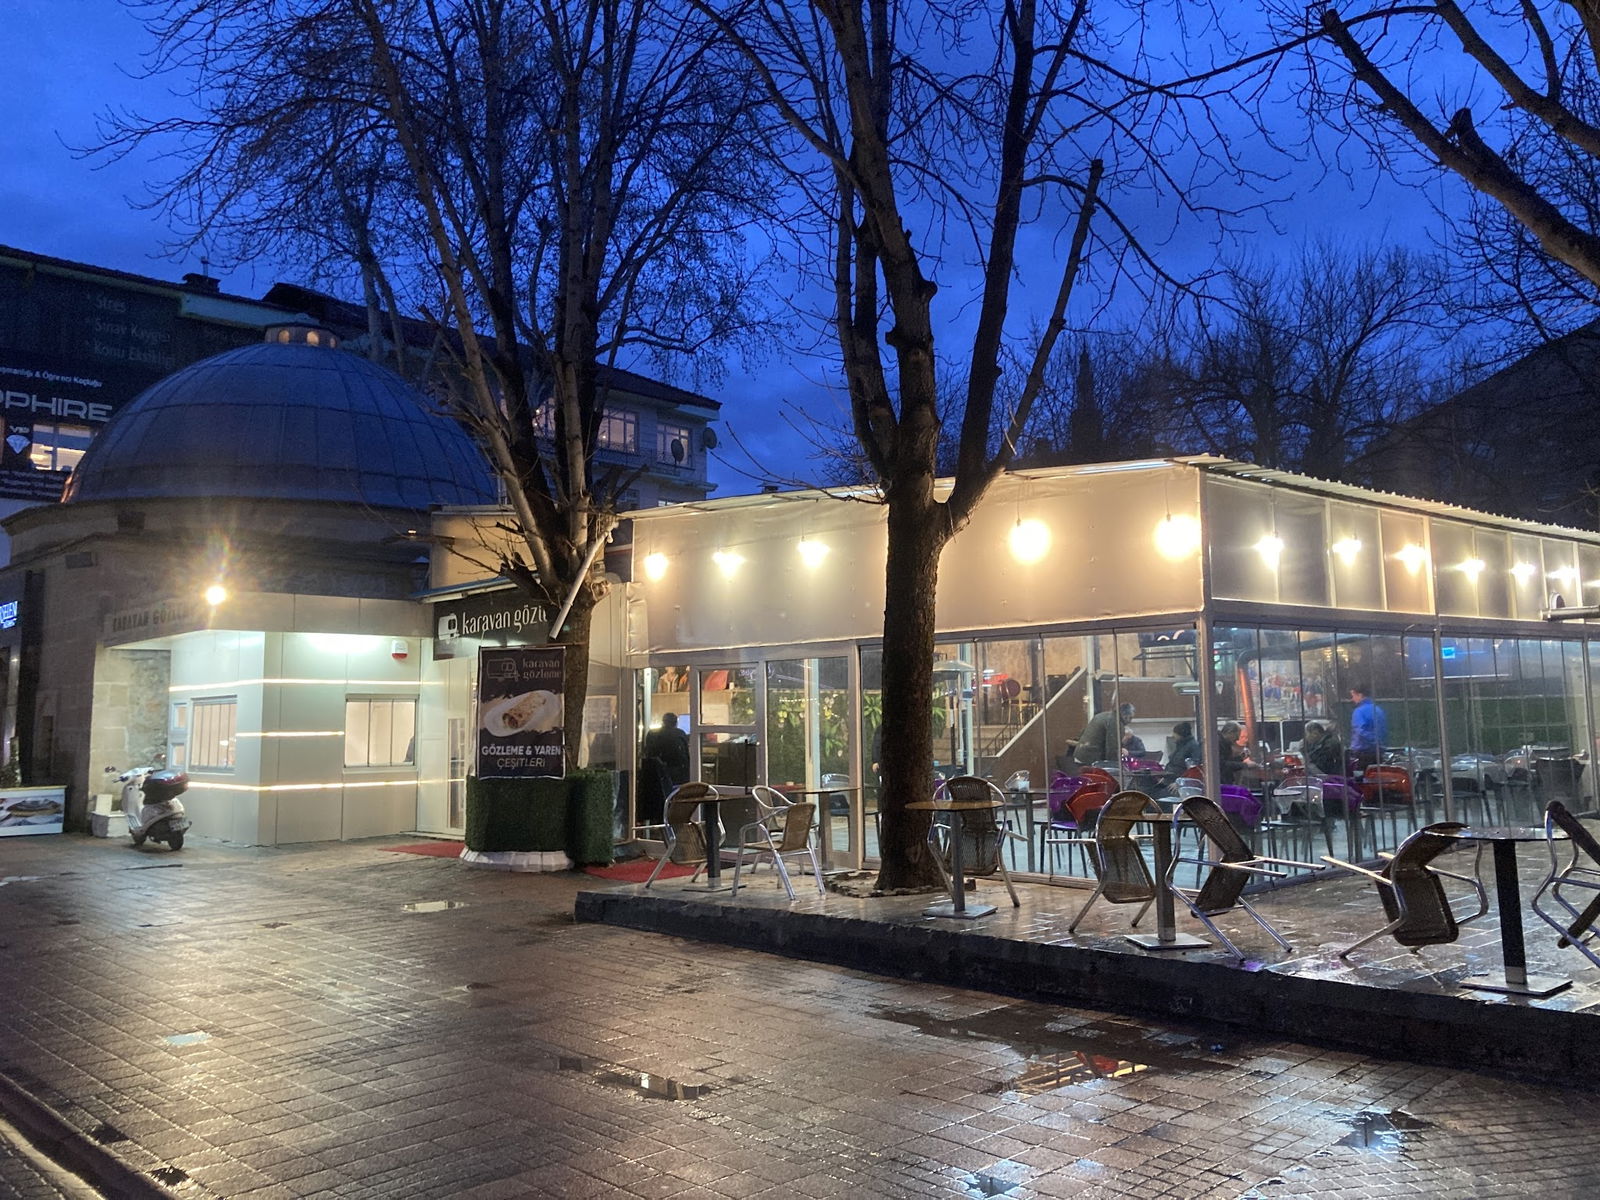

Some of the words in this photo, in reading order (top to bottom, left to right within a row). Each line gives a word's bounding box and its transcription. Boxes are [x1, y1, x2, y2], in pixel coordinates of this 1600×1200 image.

[95, 293, 126, 313] Stres
[93, 338, 126, 357] Konu
[0, 388, 113, 423] PHIRE
[462, 611, 510, 635] karavan
[522, 658, 560, 668] karavan
[523, 669, 562, 681] gözleme
[481, 743, 524, 756] GÖZLEME
[525, 746, 533, 756] &
[534, 745, 561, 756] YAREN
[496, 757, 546, 770] ÇEŞİTLERİ
